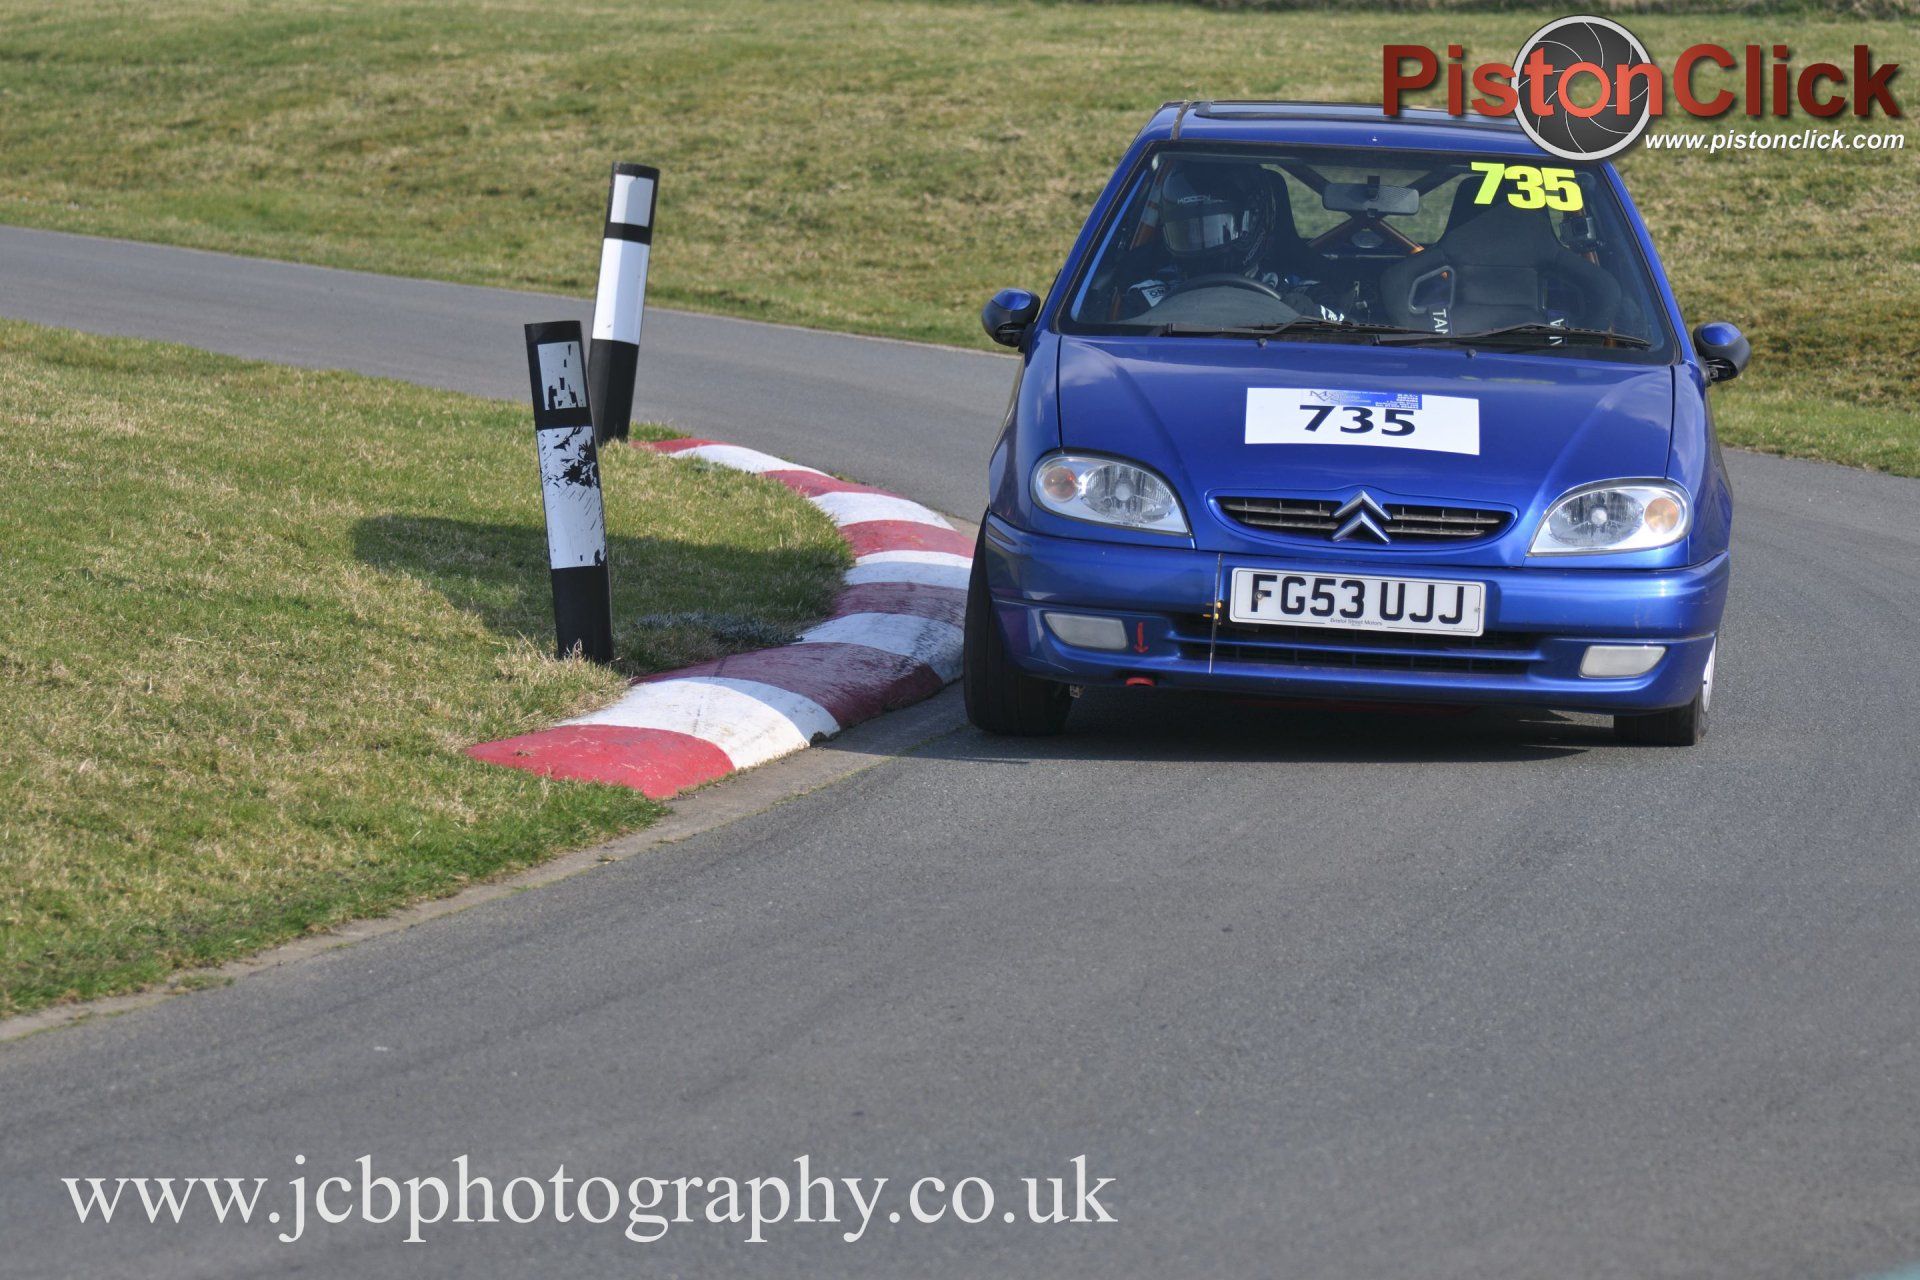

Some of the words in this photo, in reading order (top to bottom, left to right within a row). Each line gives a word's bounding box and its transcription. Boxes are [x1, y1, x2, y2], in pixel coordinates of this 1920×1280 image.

[1470, 161, 1584, 211] 735
[1299, 404, 1416, 437] 735
[1250, 573, 1366, 619] FG53
[1379, 581, 1465, 625] UJJ
